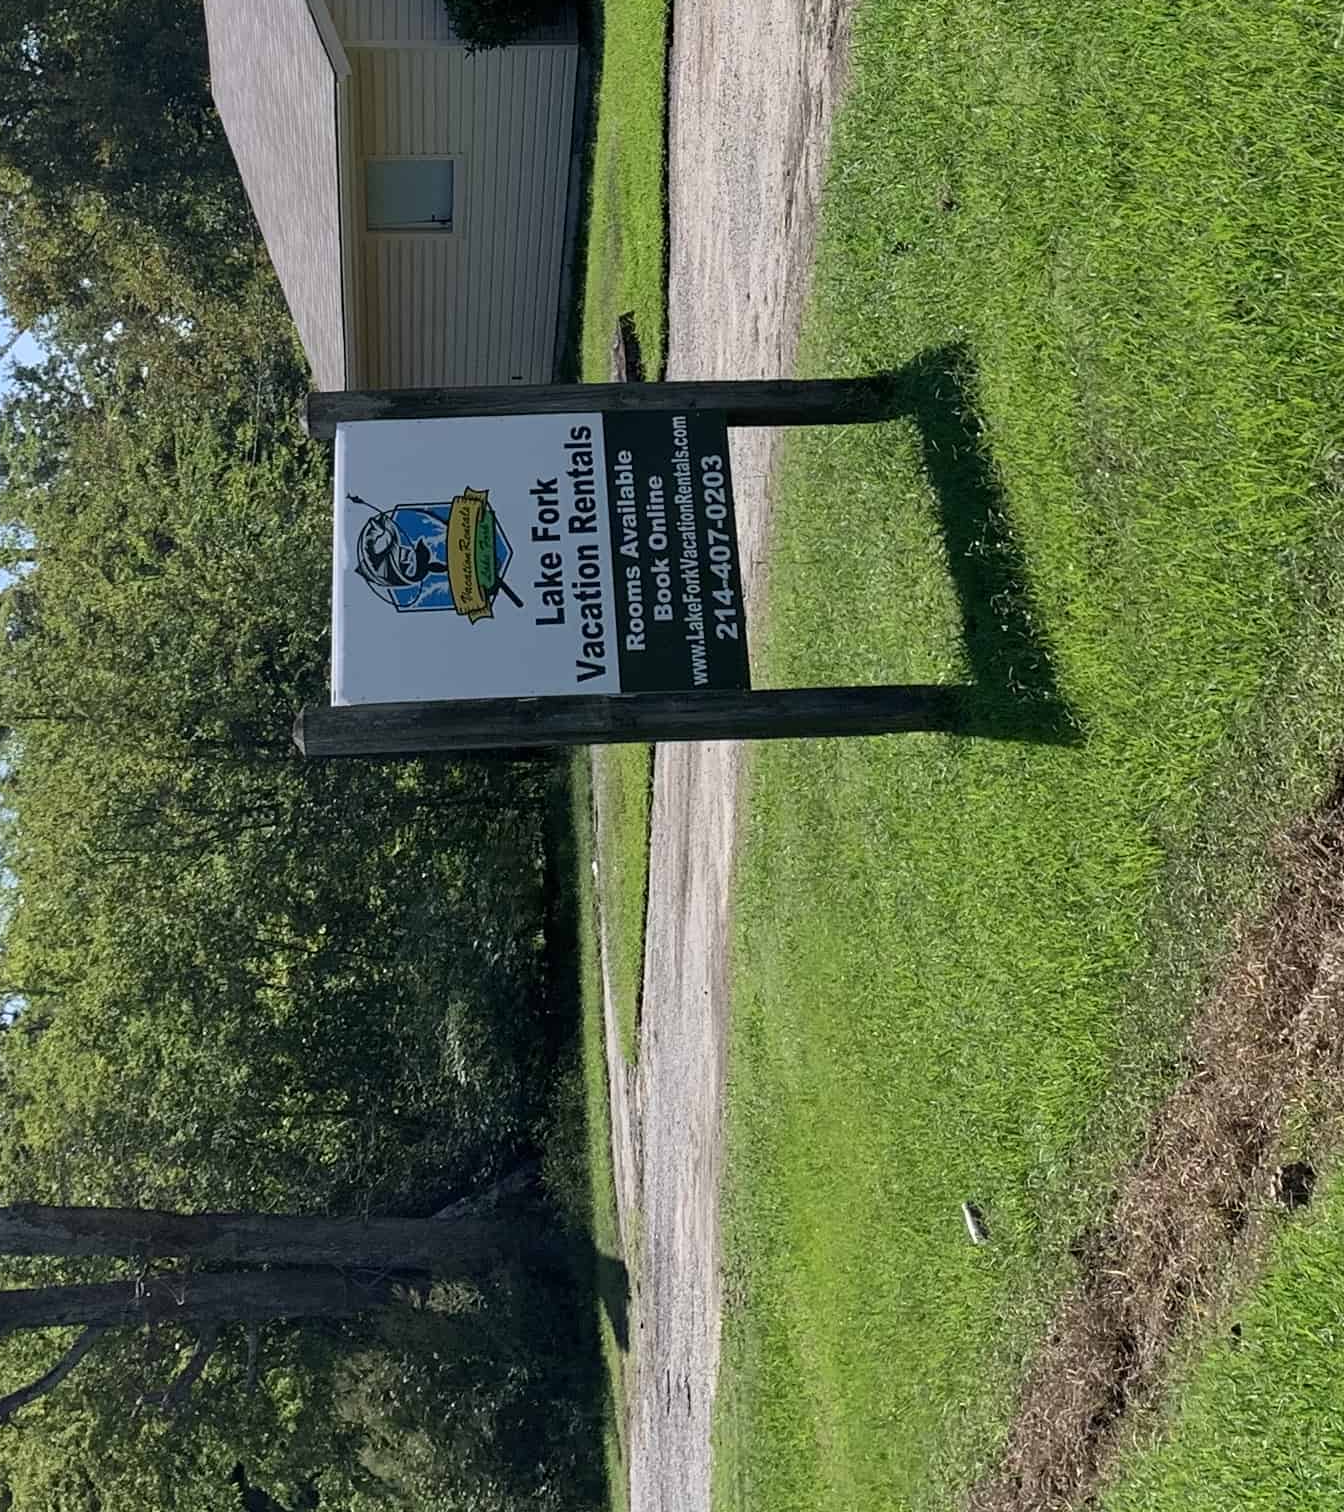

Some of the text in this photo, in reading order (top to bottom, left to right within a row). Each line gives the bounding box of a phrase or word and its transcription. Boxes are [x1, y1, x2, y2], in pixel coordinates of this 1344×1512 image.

[530, 477, 566, 626] Lake Fork
[564, 424, 607, 683] Vacation Rentals
[614, 450, 646, 651] Rooms Available
[645, 475, 673, 622] Book Online
[671, 415, 710, 687] www.LakeForkVacationRentals.com
[701, 454, 739, 640] 214-407-0203
